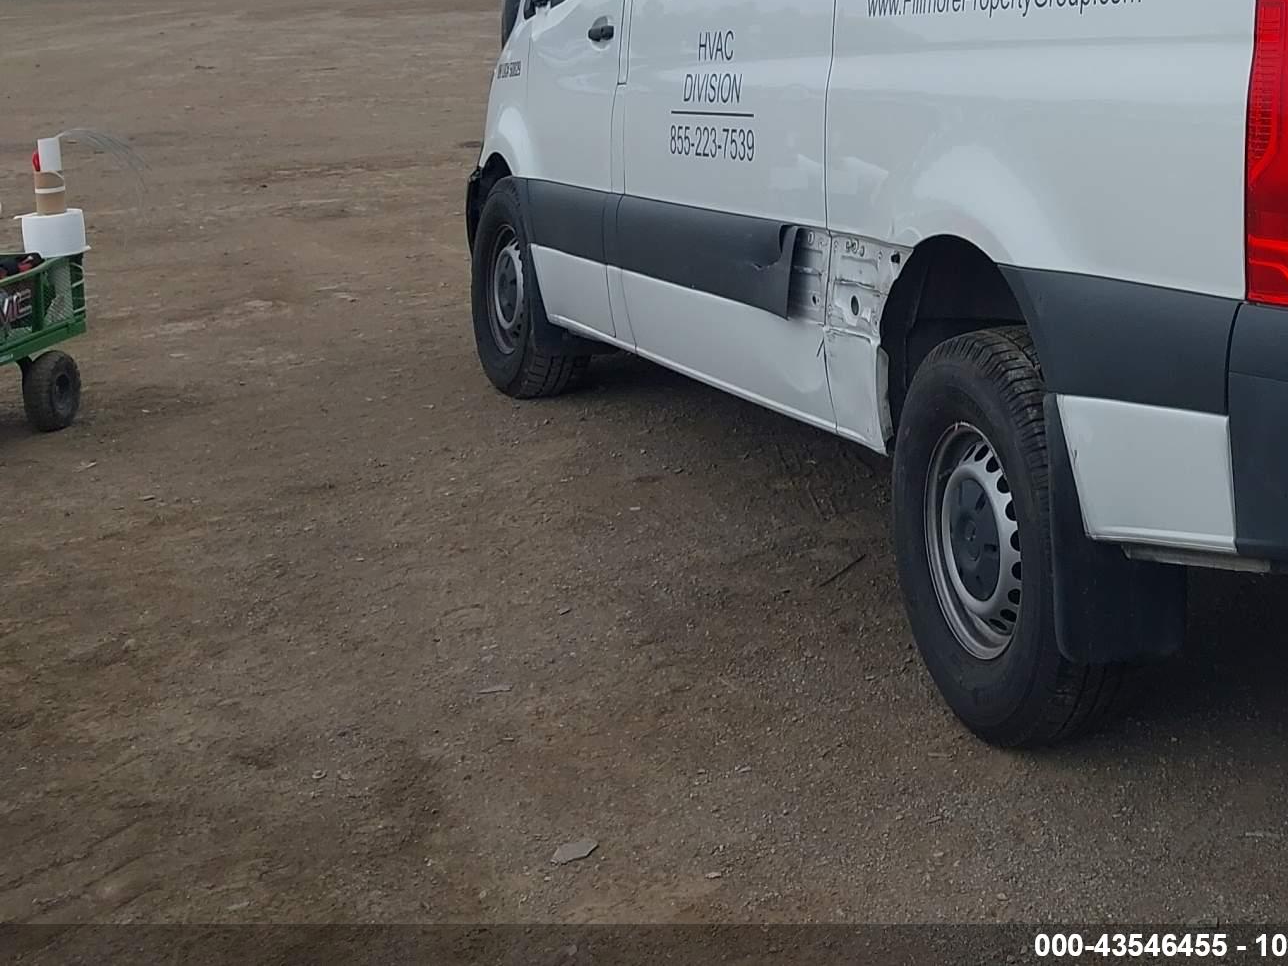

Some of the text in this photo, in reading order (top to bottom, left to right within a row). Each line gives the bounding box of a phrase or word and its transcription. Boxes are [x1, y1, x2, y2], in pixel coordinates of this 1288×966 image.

[698, 30, 734, 61] HVAC
[683, 73, 743, 103] DIVISION
[670, 124, 755, 162] 855-223-7539
